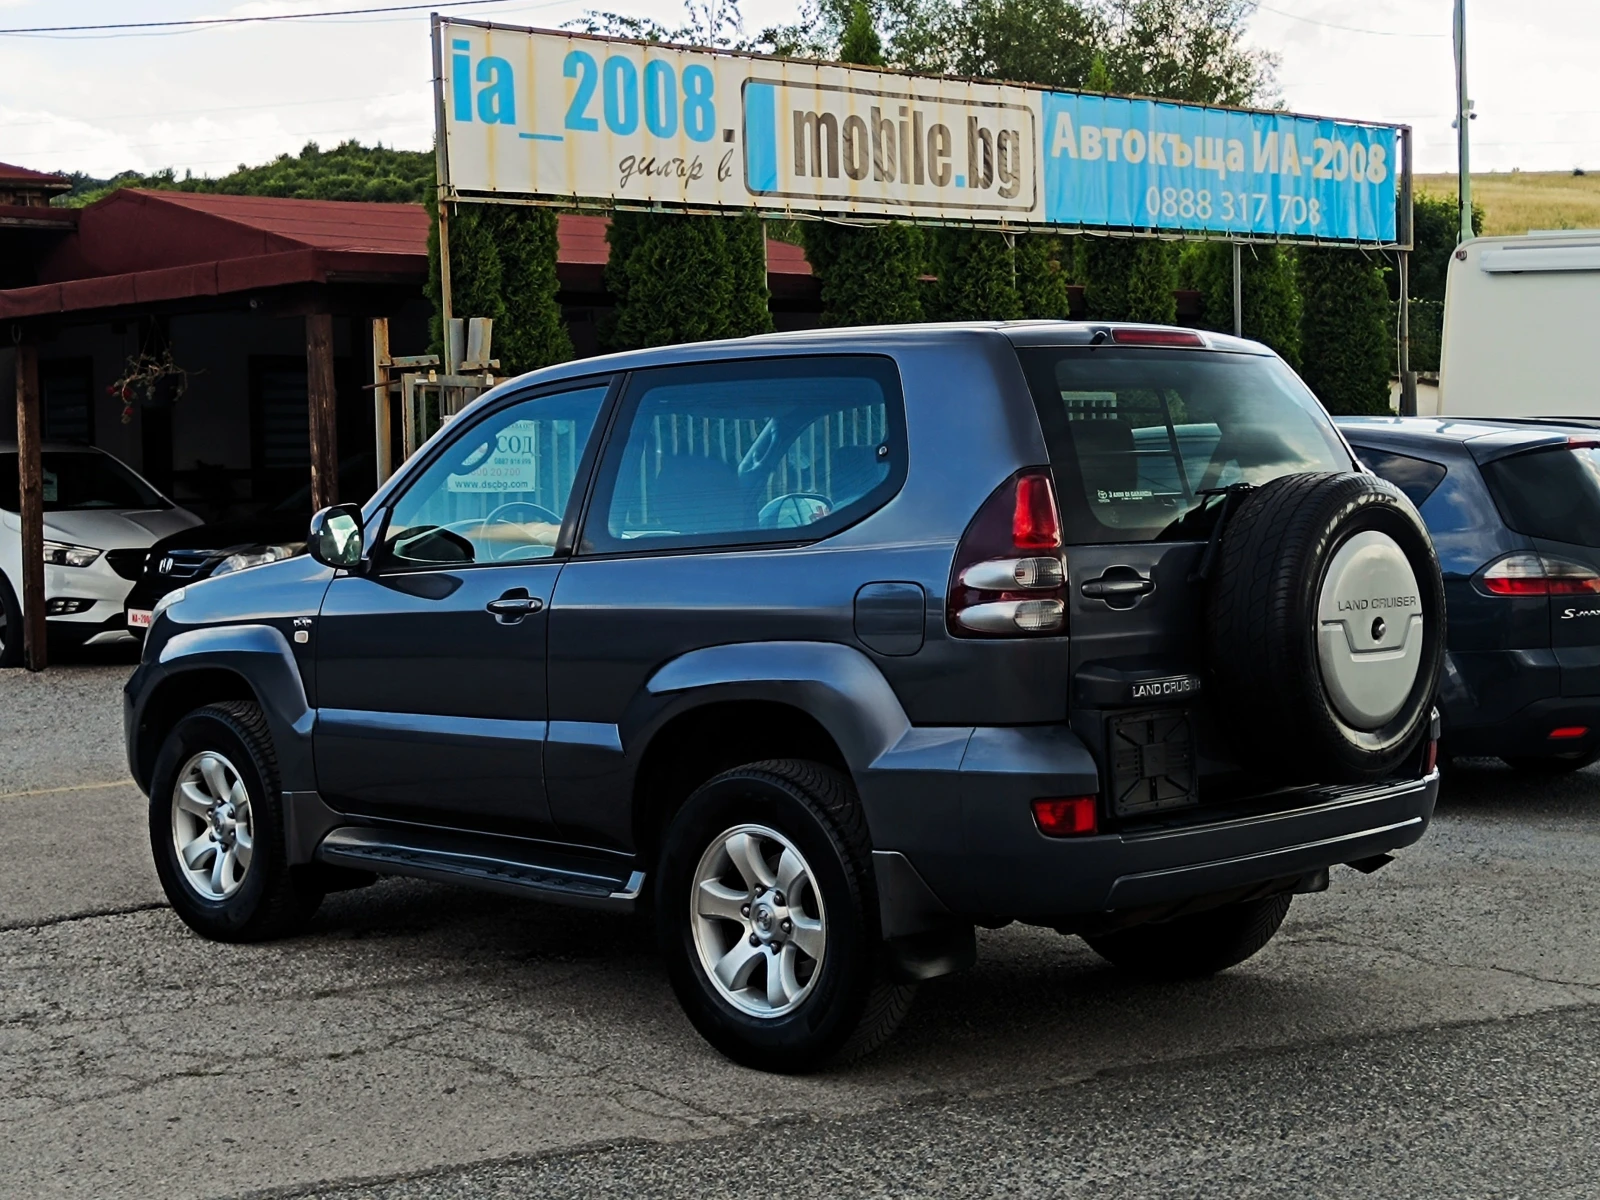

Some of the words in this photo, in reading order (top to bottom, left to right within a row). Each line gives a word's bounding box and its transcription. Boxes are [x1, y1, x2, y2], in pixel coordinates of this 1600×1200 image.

[793, 105, 1020, 199] mobile.bg
[1051, 111, 1245, 180] Автокъща
[1253, 128, 1387, 184] ИА-2008
[619, 155, 704, 189] дилър
[717, 148, 734, 182] в
[1145, 186, 1212, 220] 0888
[1220, 191, 1268, 223] 317
[1278, 194, 1321, 226] 708
[490, 467, 502, 476] 20
[504, 467, 521, 476] 700
[455, 481, 528, 490] www.dscbg.com
[1338, 600, 1368, 611] LAND
[1371, 596, 1416, 609] CRUISER
[1132, 684, 1161, 697] LAND
